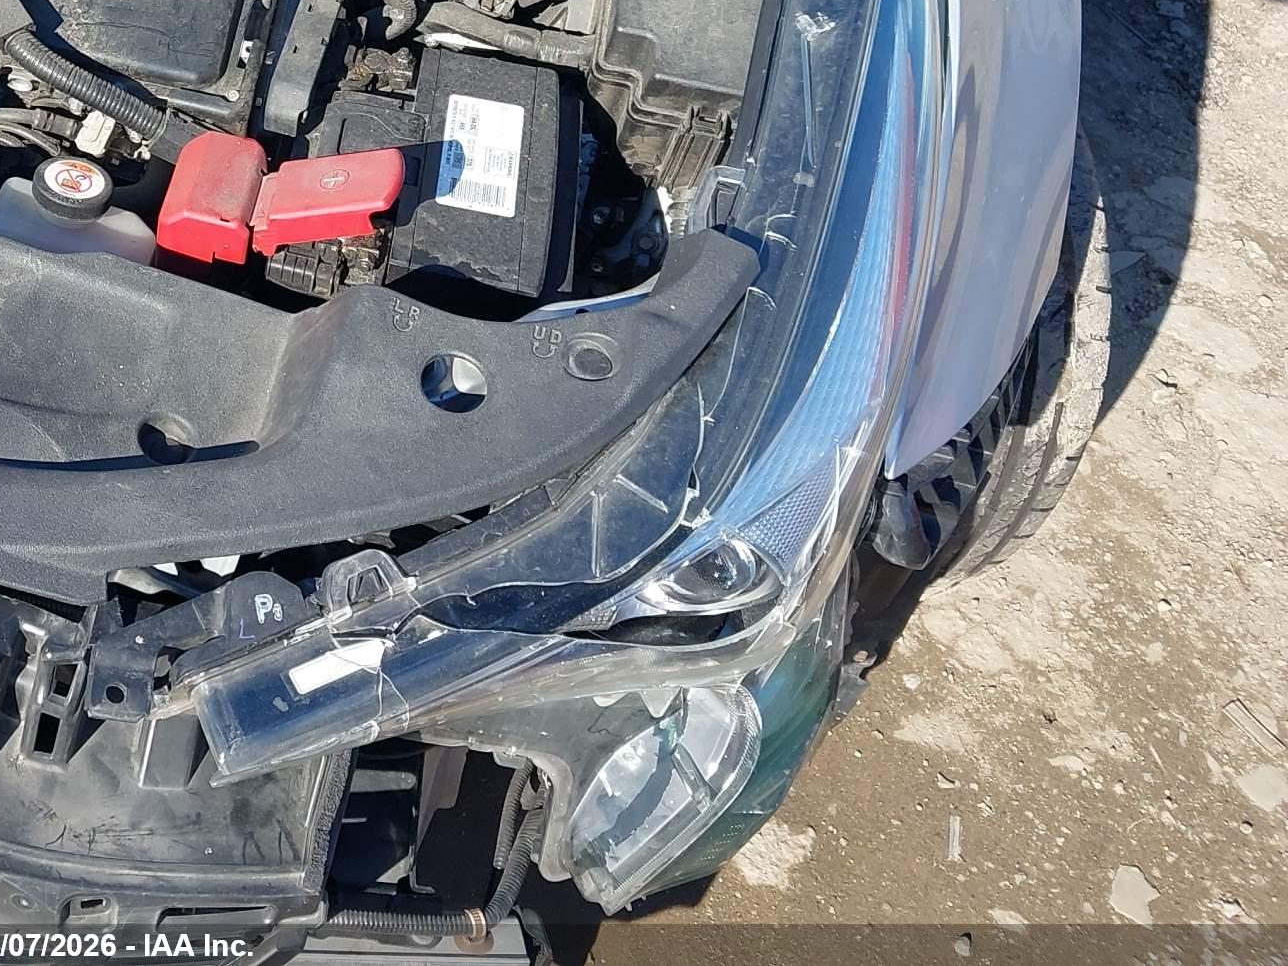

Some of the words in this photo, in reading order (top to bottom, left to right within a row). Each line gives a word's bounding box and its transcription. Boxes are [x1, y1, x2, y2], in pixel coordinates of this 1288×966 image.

[393, 296, 404, 314] L
[408, 305, 420, 320] R
[533, 324, 546, 340] U
[549, 328, 562, 344] D
